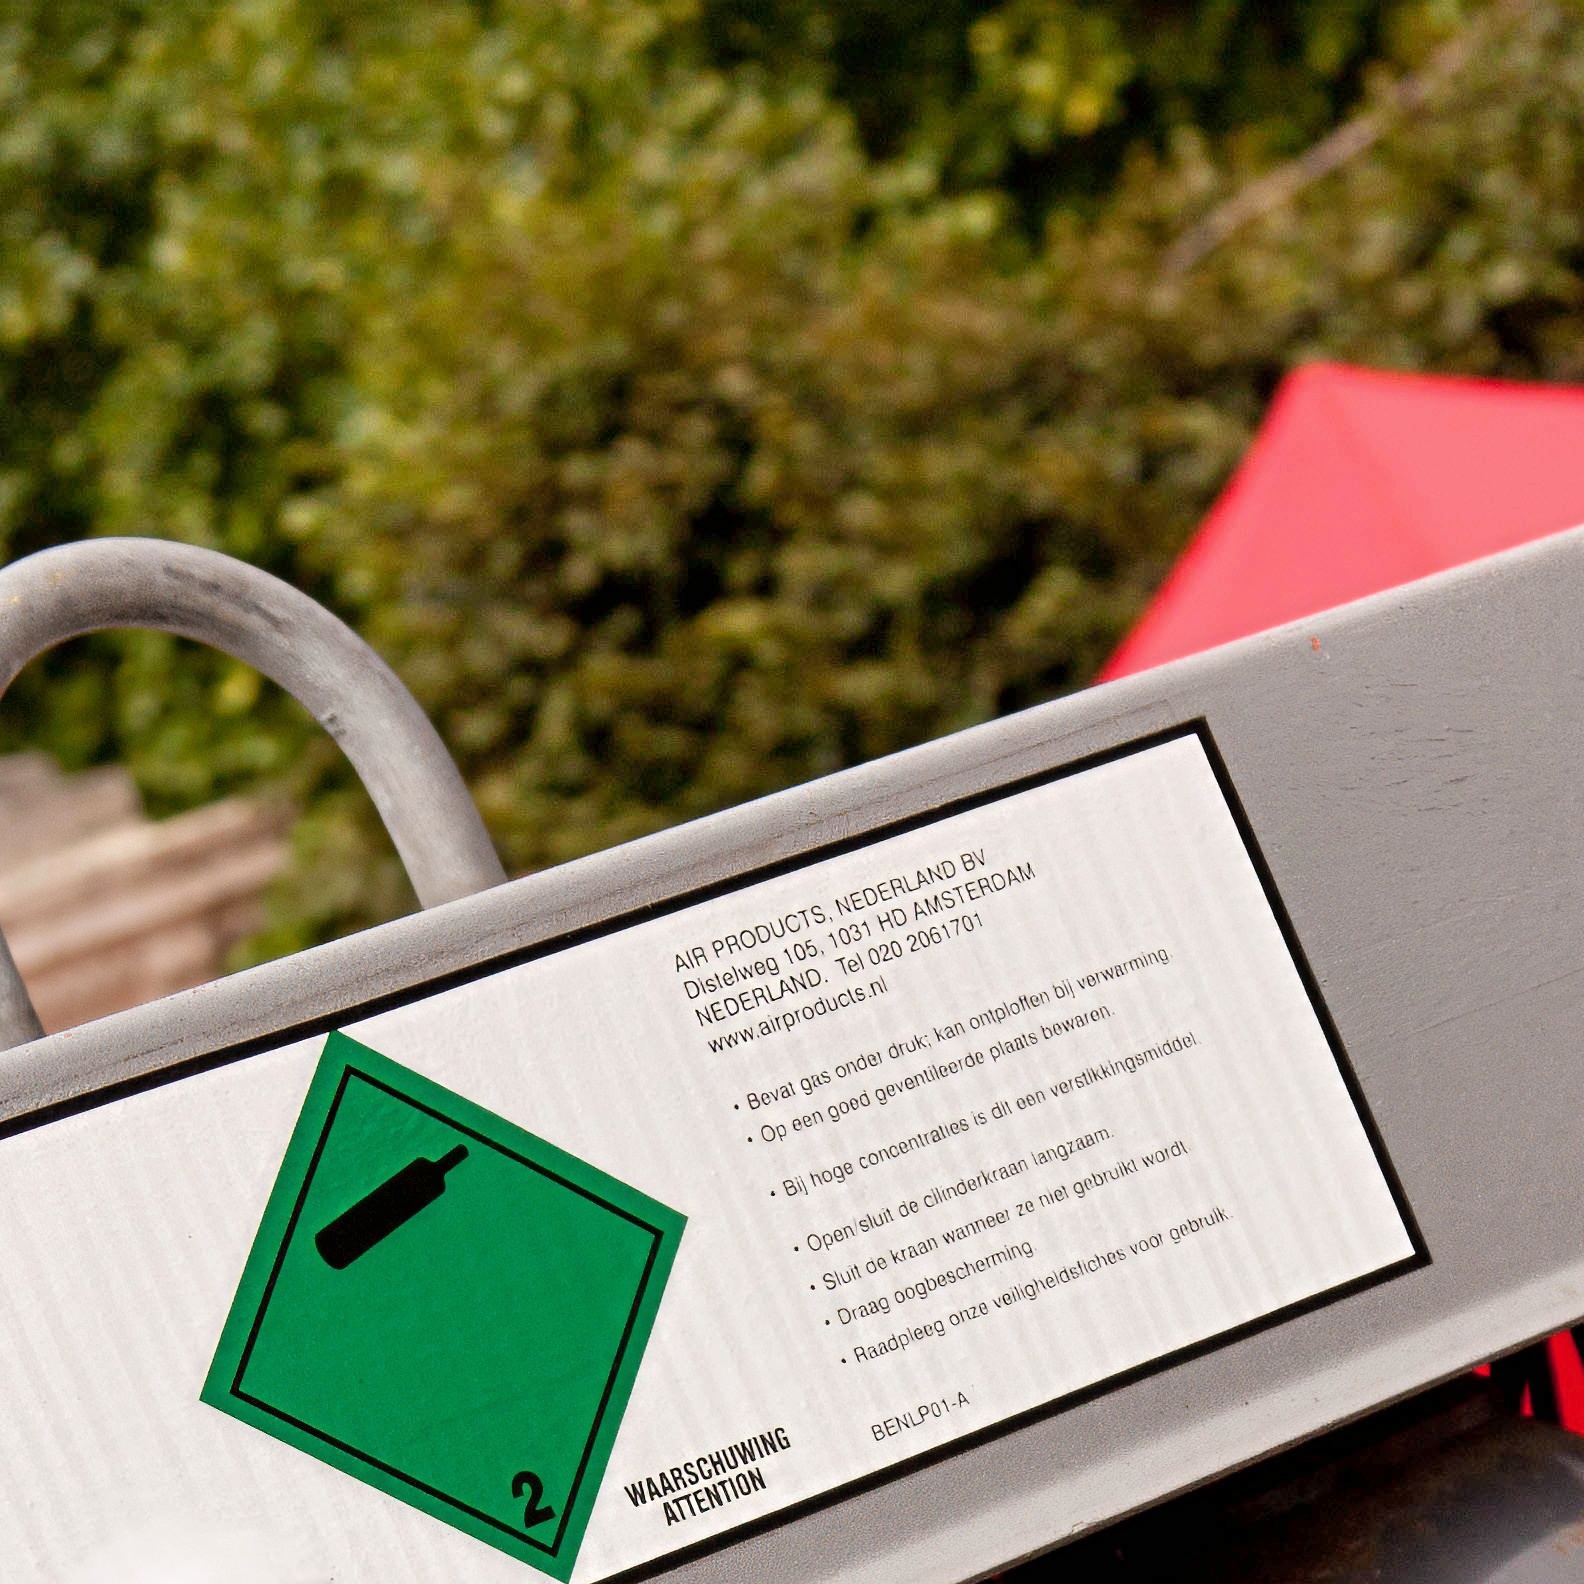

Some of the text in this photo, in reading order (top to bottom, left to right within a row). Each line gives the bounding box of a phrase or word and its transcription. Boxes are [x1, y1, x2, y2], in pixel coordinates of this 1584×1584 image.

[674, 847, 987, 974] AIR PRODUCTS, NEDERLAND BV
[682, 860, 1037, 1001] Distelweg 105, 1031 HD AMSTERDAM
[693, 911, 984, 1029] NEDERLAND. Tel 020 2061701
[706, 973, 890, 1055] www.airproducts.nl
[745, 1080, 798, 1112] Bevat
[798, 1069, 833, 1097] gas
[833, 1050, 884, 1080] onder
[885, 1033, 936, 1061] druk;
[930, 1020, 968, 1044] kan
[1050, 977, 1077, 1001] bij
[758, 1004, 1117, 1145] Op een goed geventileerde plaats bewaren.
[780, 1174, 810, 1198] Bij
[807, 1160, 856, 1189] hoge
[857, 1117, 971, 1171] concentraties
[969, 1109, 989, 1128] is
[989, 1098, 1014, 1121] dit
[1013, 1089, 1048, 1112] een
[895, 1199, 921, 1219] de
[922, 1158, 1031, 1210] cilinderkraan
[1029, 1127, 1116, 1168] langzaam.
[821, 1262, 864, 1292] Sluit
[863, 1255, 891, 1276] de
[887, 1236, 941, 1266] kraan
[939, 1207, 1012, 1246] wanneer
[1014, 1198, 1037, 1218] ze
[1036, 1183, 1071, 1209] niet
[1071, 1157, 1138, 1200] gebruikt
[835, 1295, 893, 1327] Draag
[851, 1318, 948, 1365] Raadpleeg
[946, 1300, 991, 1328] onze
[1126, 1231, 1165, 1257] voor
[622, 1426, 793, 1509] WAARSCHUWING
[869, 1390, 972, 1443] BENLP01-A
[510, 1469, 557, 1529] 2
[661, 1465, 768, 1528] ATTENTION
